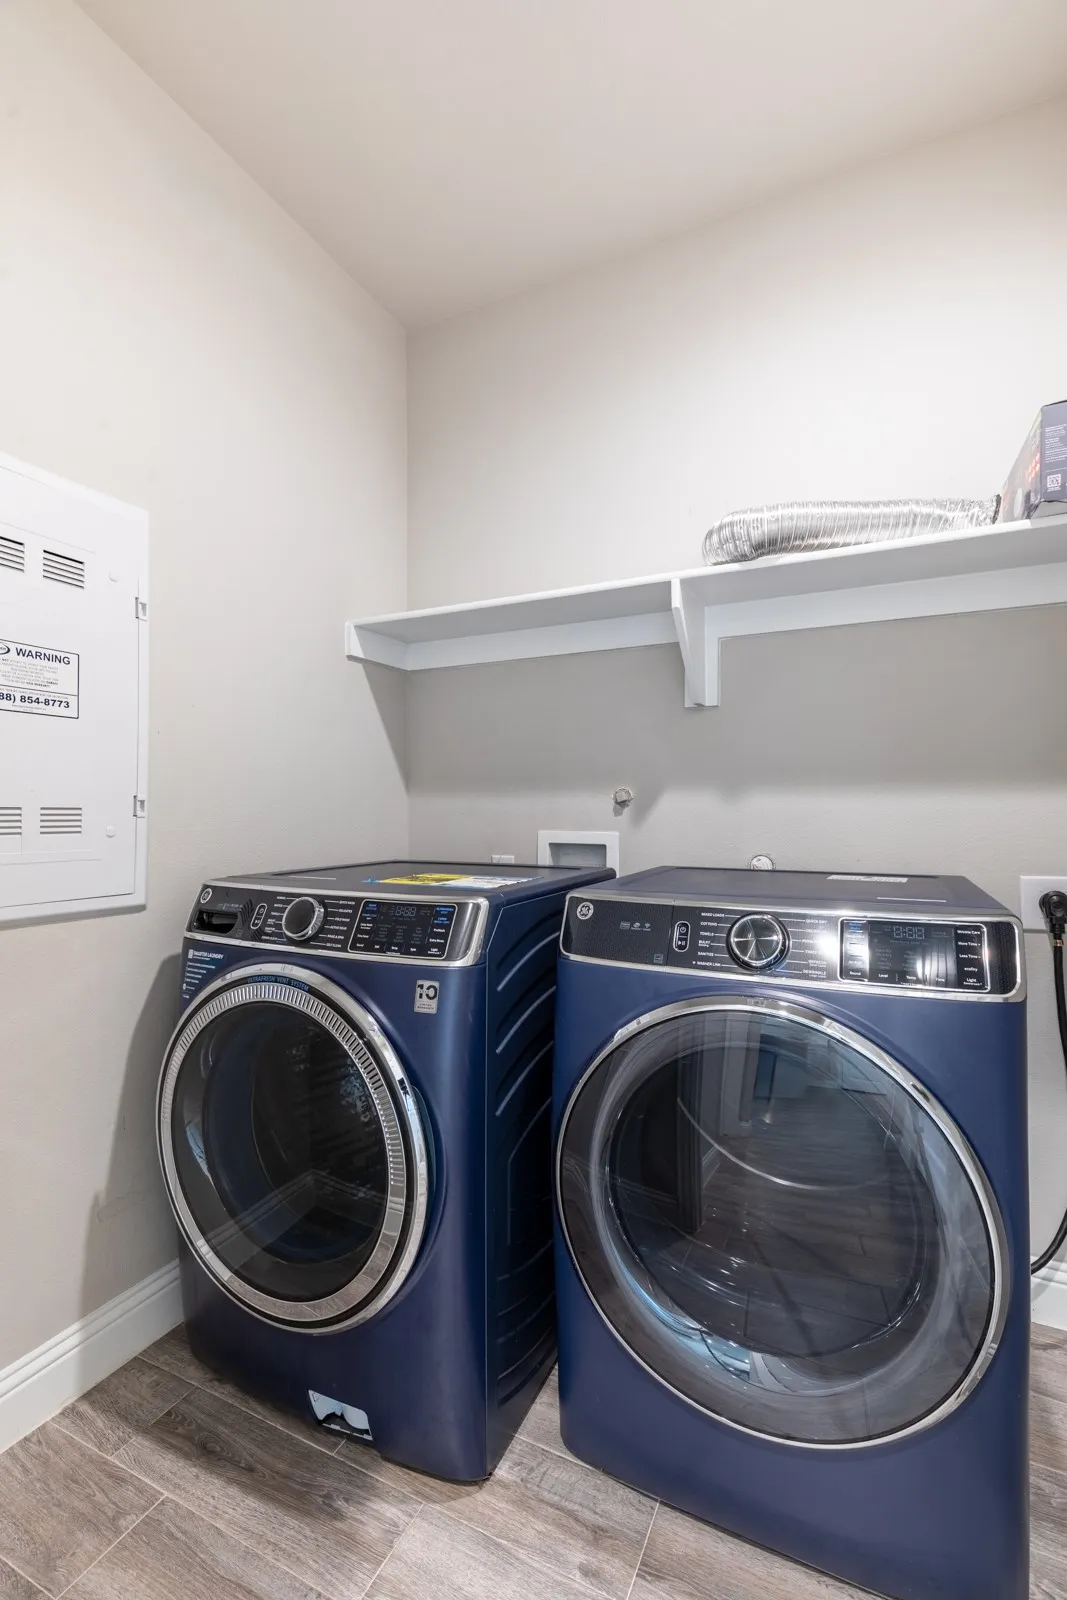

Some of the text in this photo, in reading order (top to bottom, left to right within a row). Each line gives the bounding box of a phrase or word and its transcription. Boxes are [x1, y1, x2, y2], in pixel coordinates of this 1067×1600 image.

[15, 647, 71, 665] WARNING
[20, 695, 70, 708] 854-8773
[291, 978, 309, 991] SYSTEM
[417, 984, 438, 1000] 10
